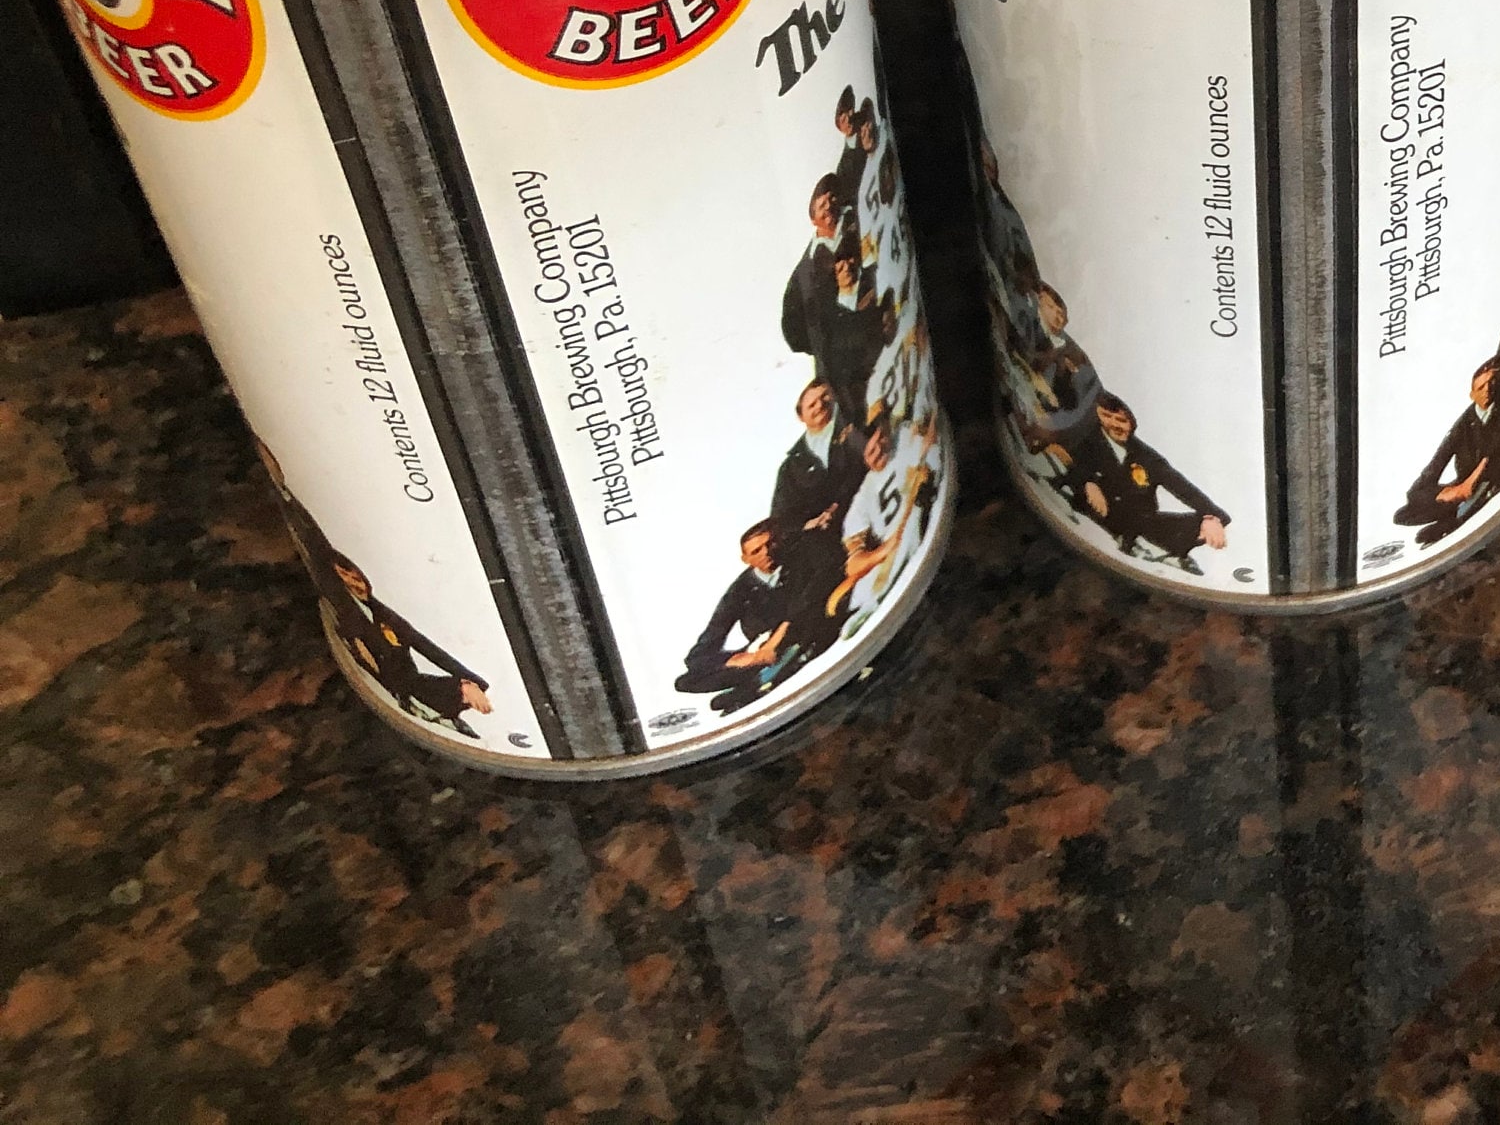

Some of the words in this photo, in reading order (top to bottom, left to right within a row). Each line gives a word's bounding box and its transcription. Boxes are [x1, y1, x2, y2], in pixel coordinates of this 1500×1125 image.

[1207, 75, 1231, 158] ounces
[1380, 15, 1418, 142] Company
[1417, 58, 1447, 138] 15201
[1201, 163, 1232, 211] fluid
[1380, 143, 1416, 247] Brewing
[1416, 136, 1444, 180] Pa.
[511, 170, 572, 304] Company
[564, 213, 619, 298] 15201
[1204, 215, 1234, 241] 12
[1415, 176, 1449, 301] Pittsburgh,
[319, 233, 368, 321] ounces
[593, 294, 630, 342] Pa.
[1209, 245, 1238, 338] Contents
[1379, 245, 1414, 358] Pittsburgh
[342, 324, 388, 374] fluid
[362, 377, 399, 405] 12
[553, 303, 604, 411] Brewing
[603, 335, 665, 467] Pittsburgh,
[383, 408, 435, 503] Contents
[576, 410, 638, 526] Pittsburgh
